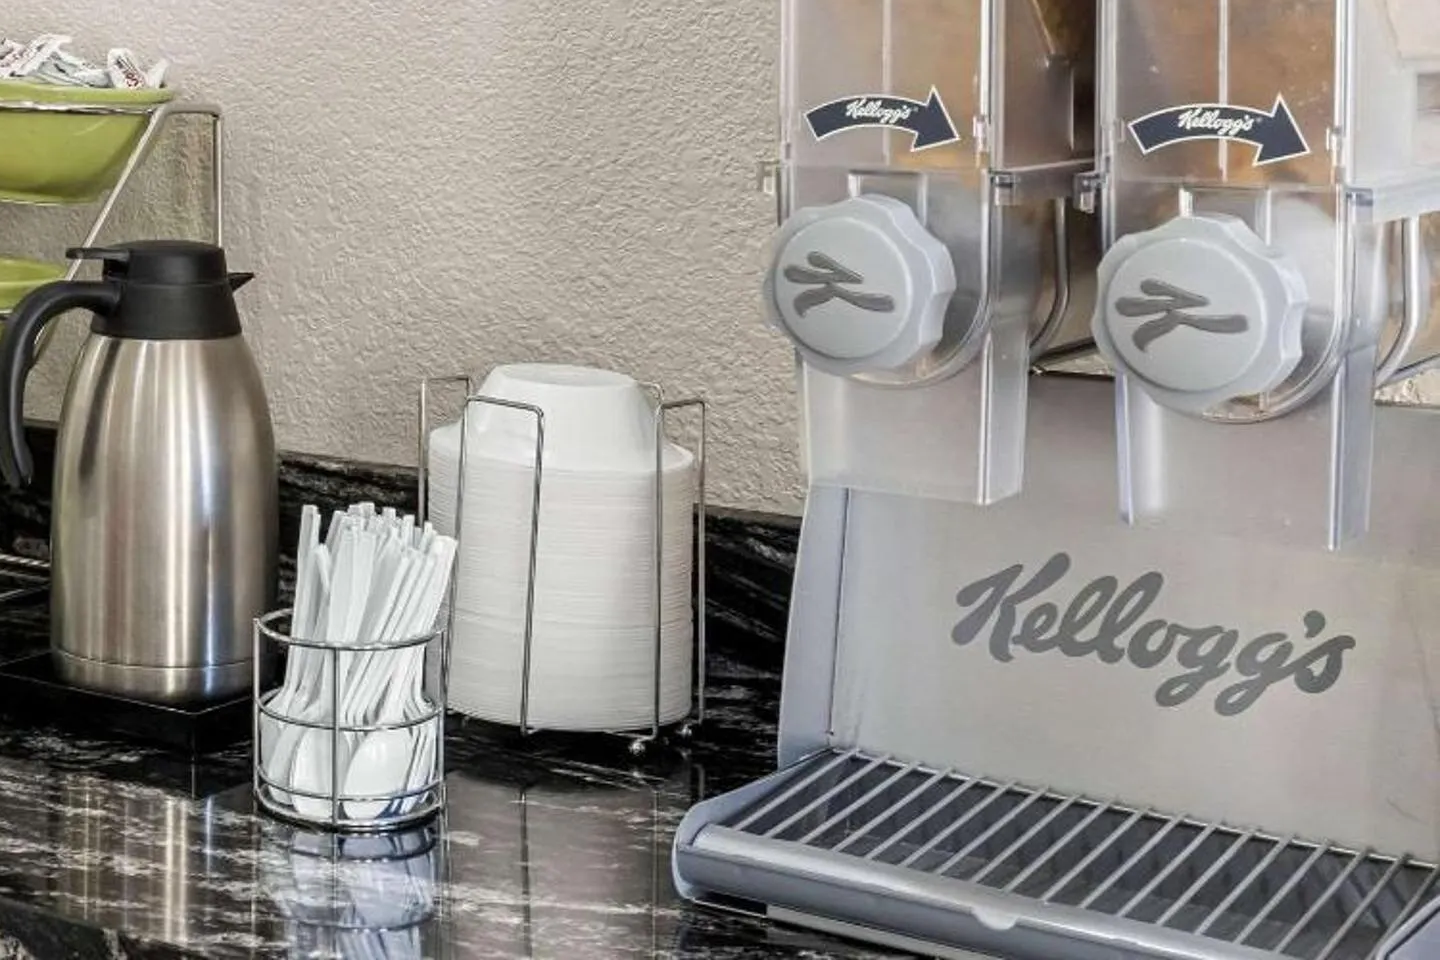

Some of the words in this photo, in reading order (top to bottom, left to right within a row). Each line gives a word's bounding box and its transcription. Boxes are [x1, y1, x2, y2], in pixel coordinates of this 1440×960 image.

[845, 97, 912, 125] Kellogg's
[1177, 106, 1255, 137] Kellogg's
[951, 551, 1357, 716] Kellogg's
